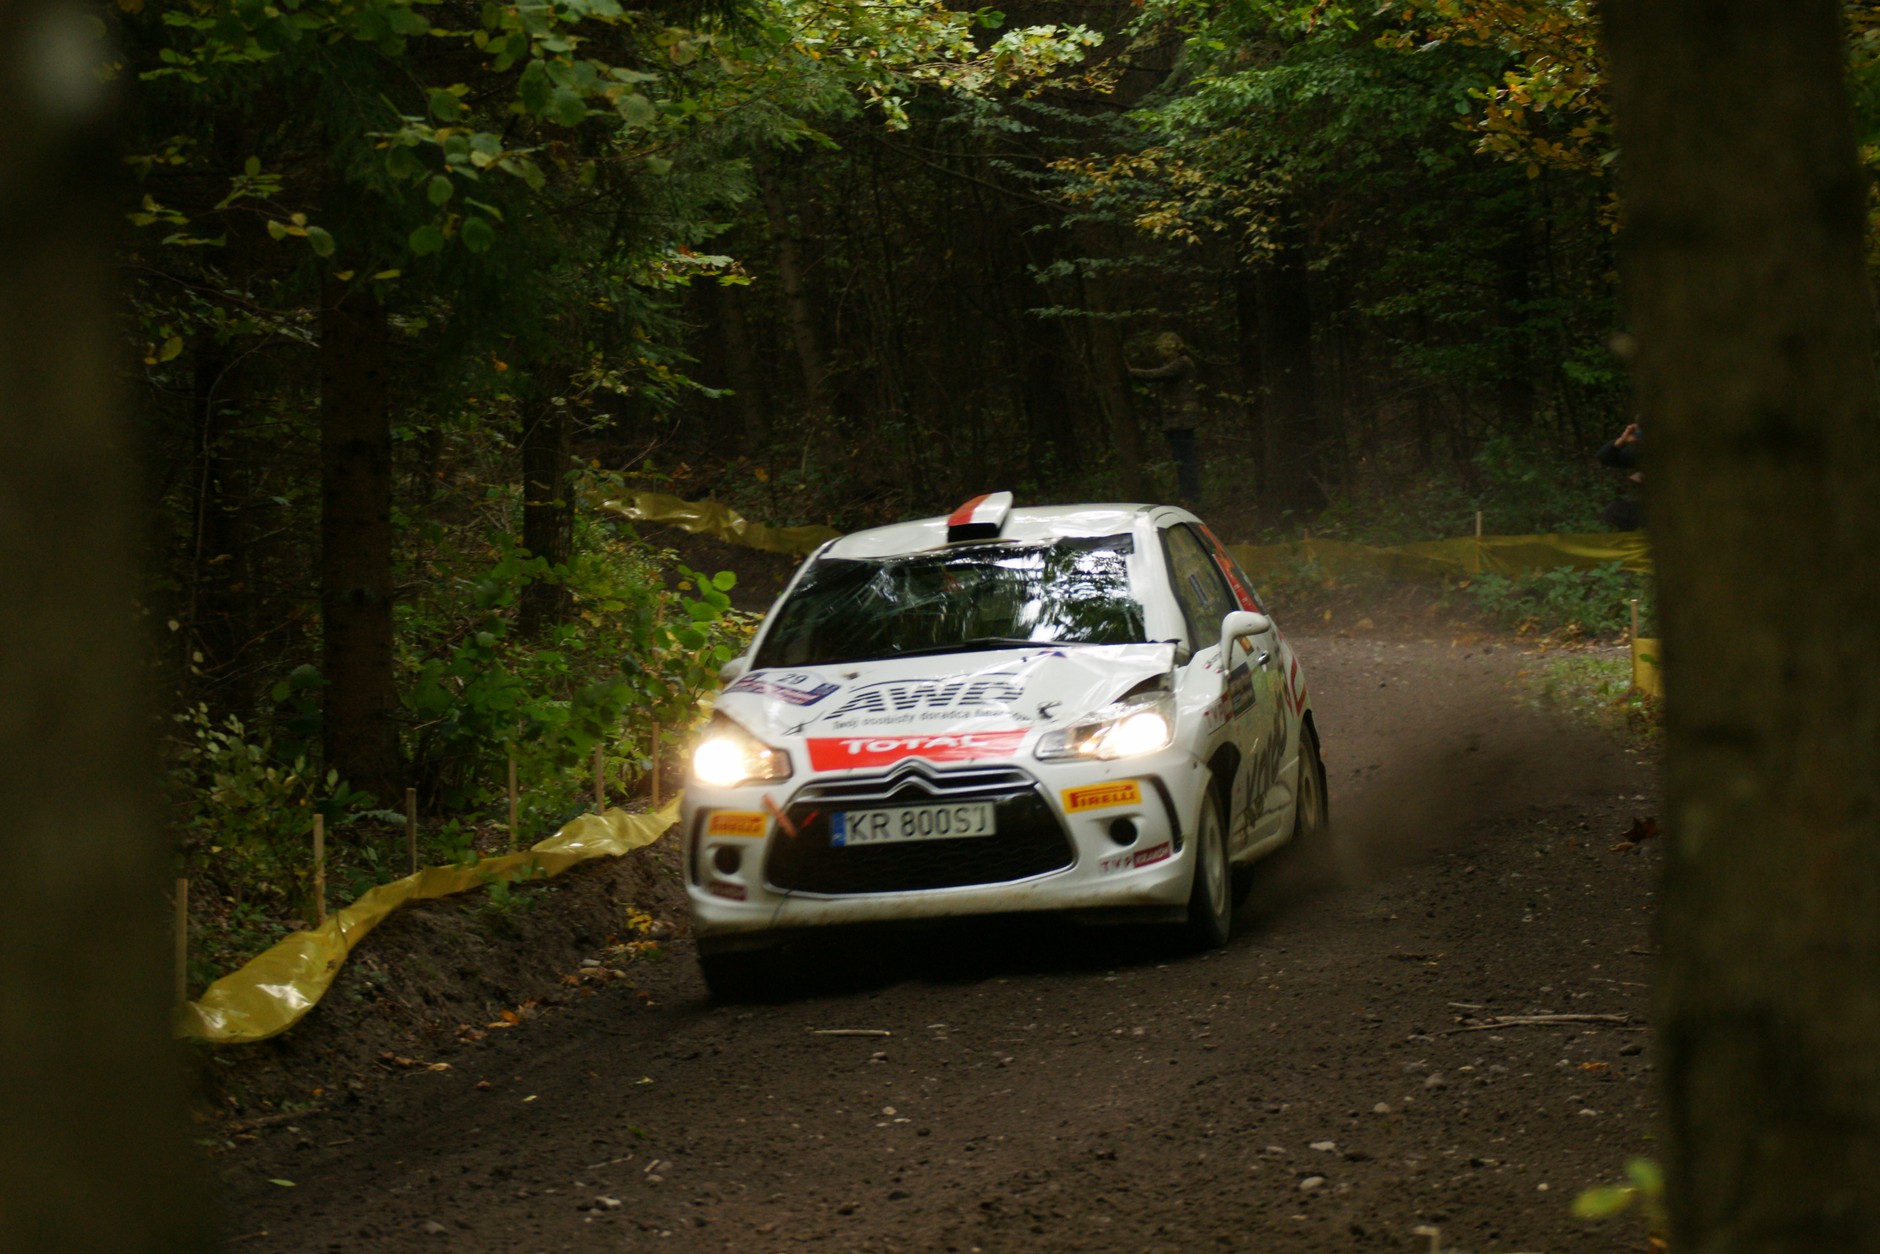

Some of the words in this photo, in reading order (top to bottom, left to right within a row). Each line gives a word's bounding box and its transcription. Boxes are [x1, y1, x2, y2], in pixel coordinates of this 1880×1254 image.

[776, 673, 809, 685] 29
[823, 681, 1023, 722] AWD
[839, 735, 988, 755] TOTAL
[1068, 783, 1136, 809] PIRELLI
[846, 812, 891, 842] KR
[899, 805, 987, 838] 800SJ
